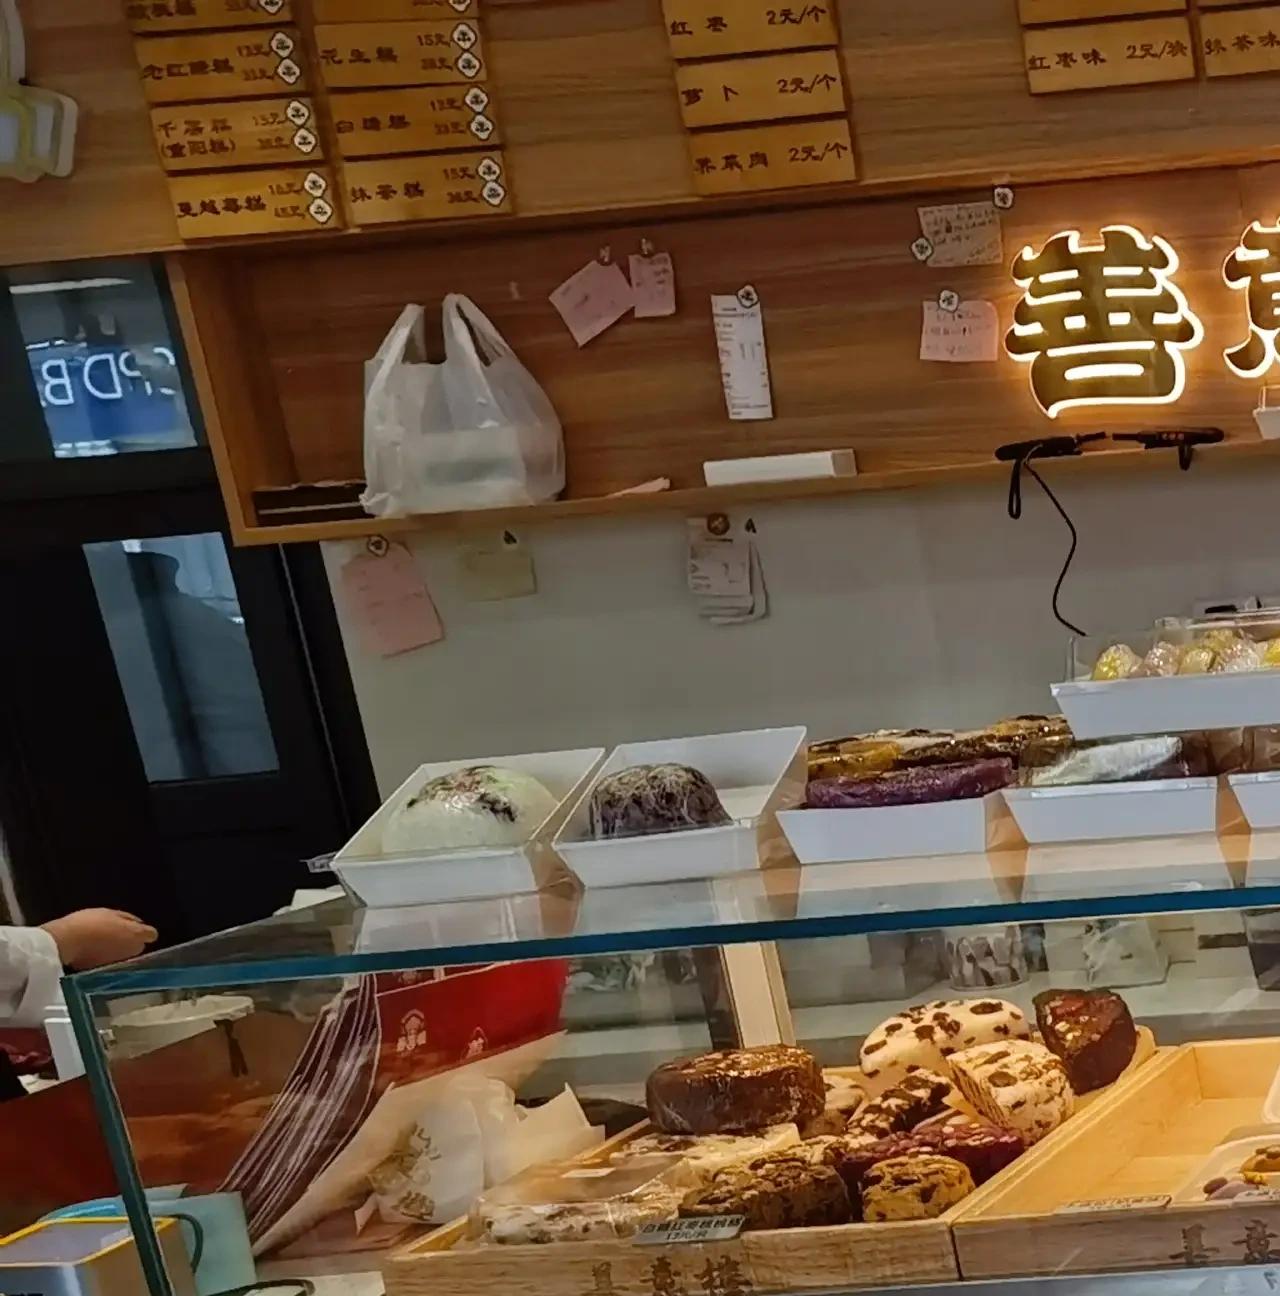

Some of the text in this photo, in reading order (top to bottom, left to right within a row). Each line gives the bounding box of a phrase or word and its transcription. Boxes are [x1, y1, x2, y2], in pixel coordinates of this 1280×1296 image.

[766, 5, 827, 26] 2元/个
[1027, 40, 1188, 70] 红枣味 2元/块
[776, 74, 837, 94] 2元/个
[788, 142, 848, 163] 2元/个
